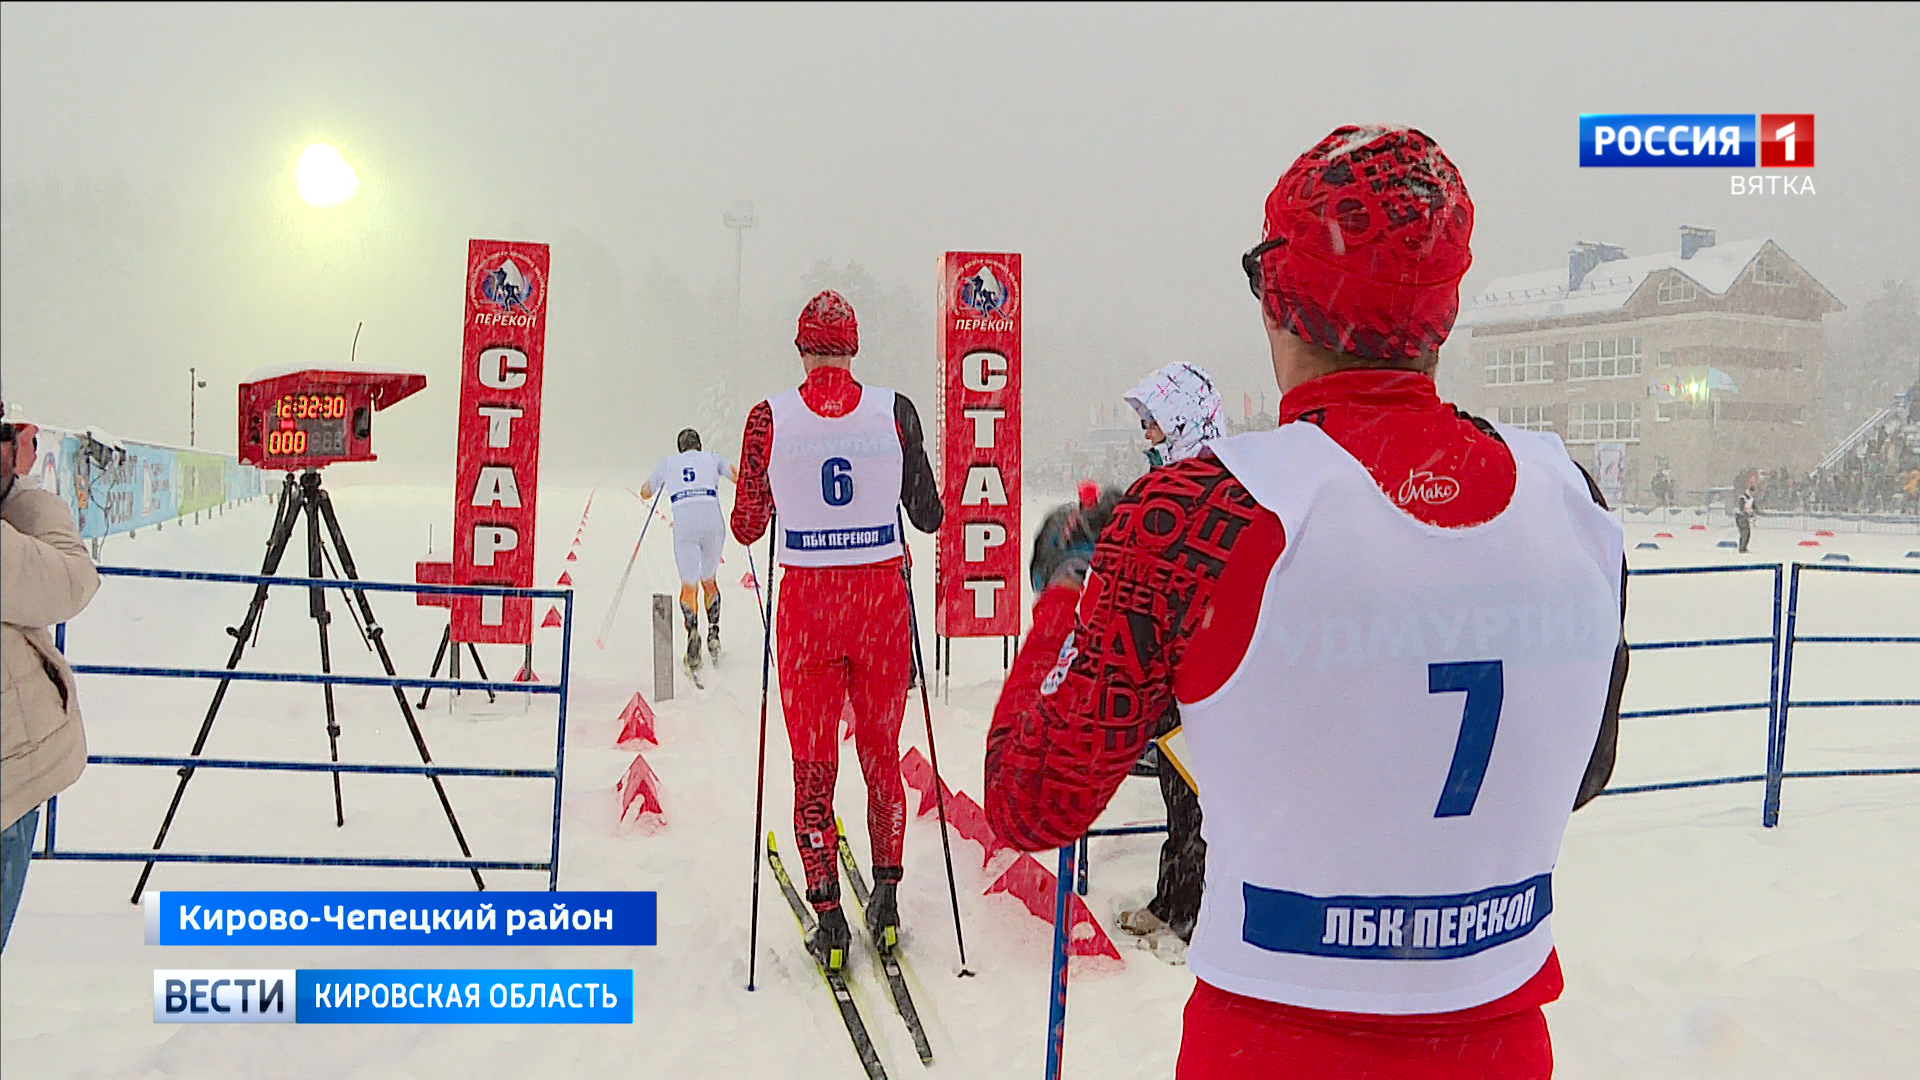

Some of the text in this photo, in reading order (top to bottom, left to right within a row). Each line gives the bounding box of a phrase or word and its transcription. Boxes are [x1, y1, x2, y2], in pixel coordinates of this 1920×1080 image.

[474, 312, 538, 328] ПЕРЕКОП
[955, 319, 1015, 332] ПЕРЕКОП
[275, 394, 345, 418] 12:32:30
[269, 430, 307, 455] 000
[682, 467, 696, 482] 5
[821, 457, 854, 506] 6
[961, 352, 1009, 618] СТАРТ
[828, 530, 879, 547] ПЕРЕКОП
[1427, 659, 1504, 818] 7
[1322, 886, 1537, 949] ЛБК ПЕРЕКОП
